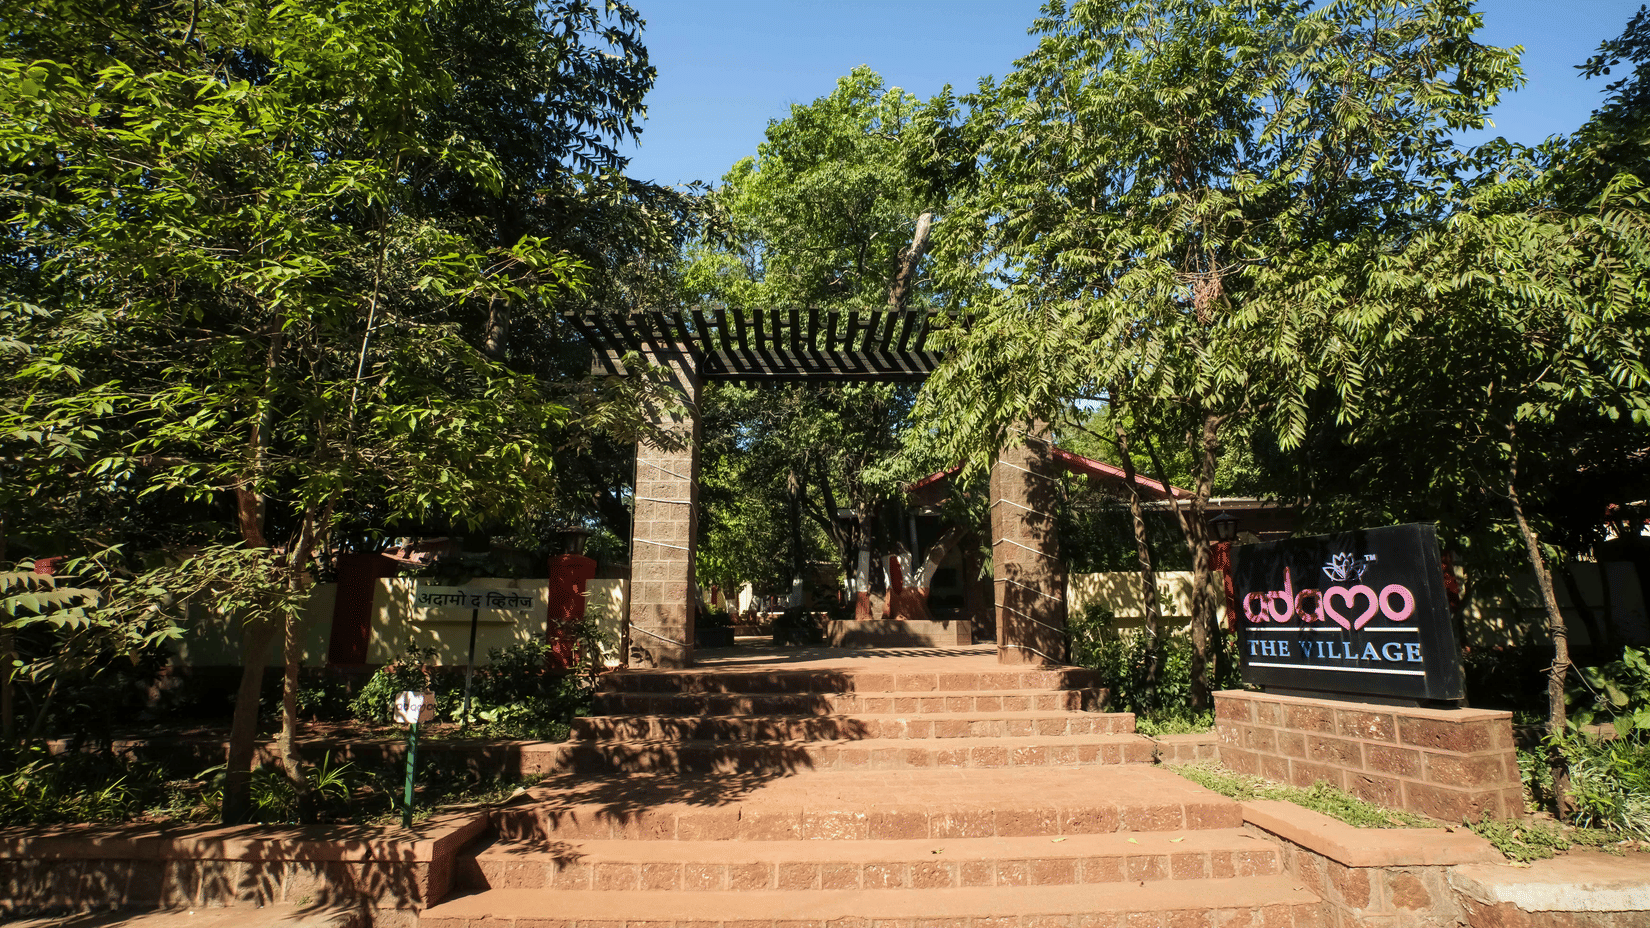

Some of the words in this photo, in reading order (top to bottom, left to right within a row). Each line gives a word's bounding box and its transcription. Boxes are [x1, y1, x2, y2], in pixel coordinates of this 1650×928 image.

[418, 590, 467, 607] अदामो
[470, 594, 483, 608] द
[486, 591, 533, 608] व्हिलेज
[1243, 566, 1415, 631] adamo
[1247, 639, 1291, 657] THE
[1298, 640, 1423, 663] VILLAGE
